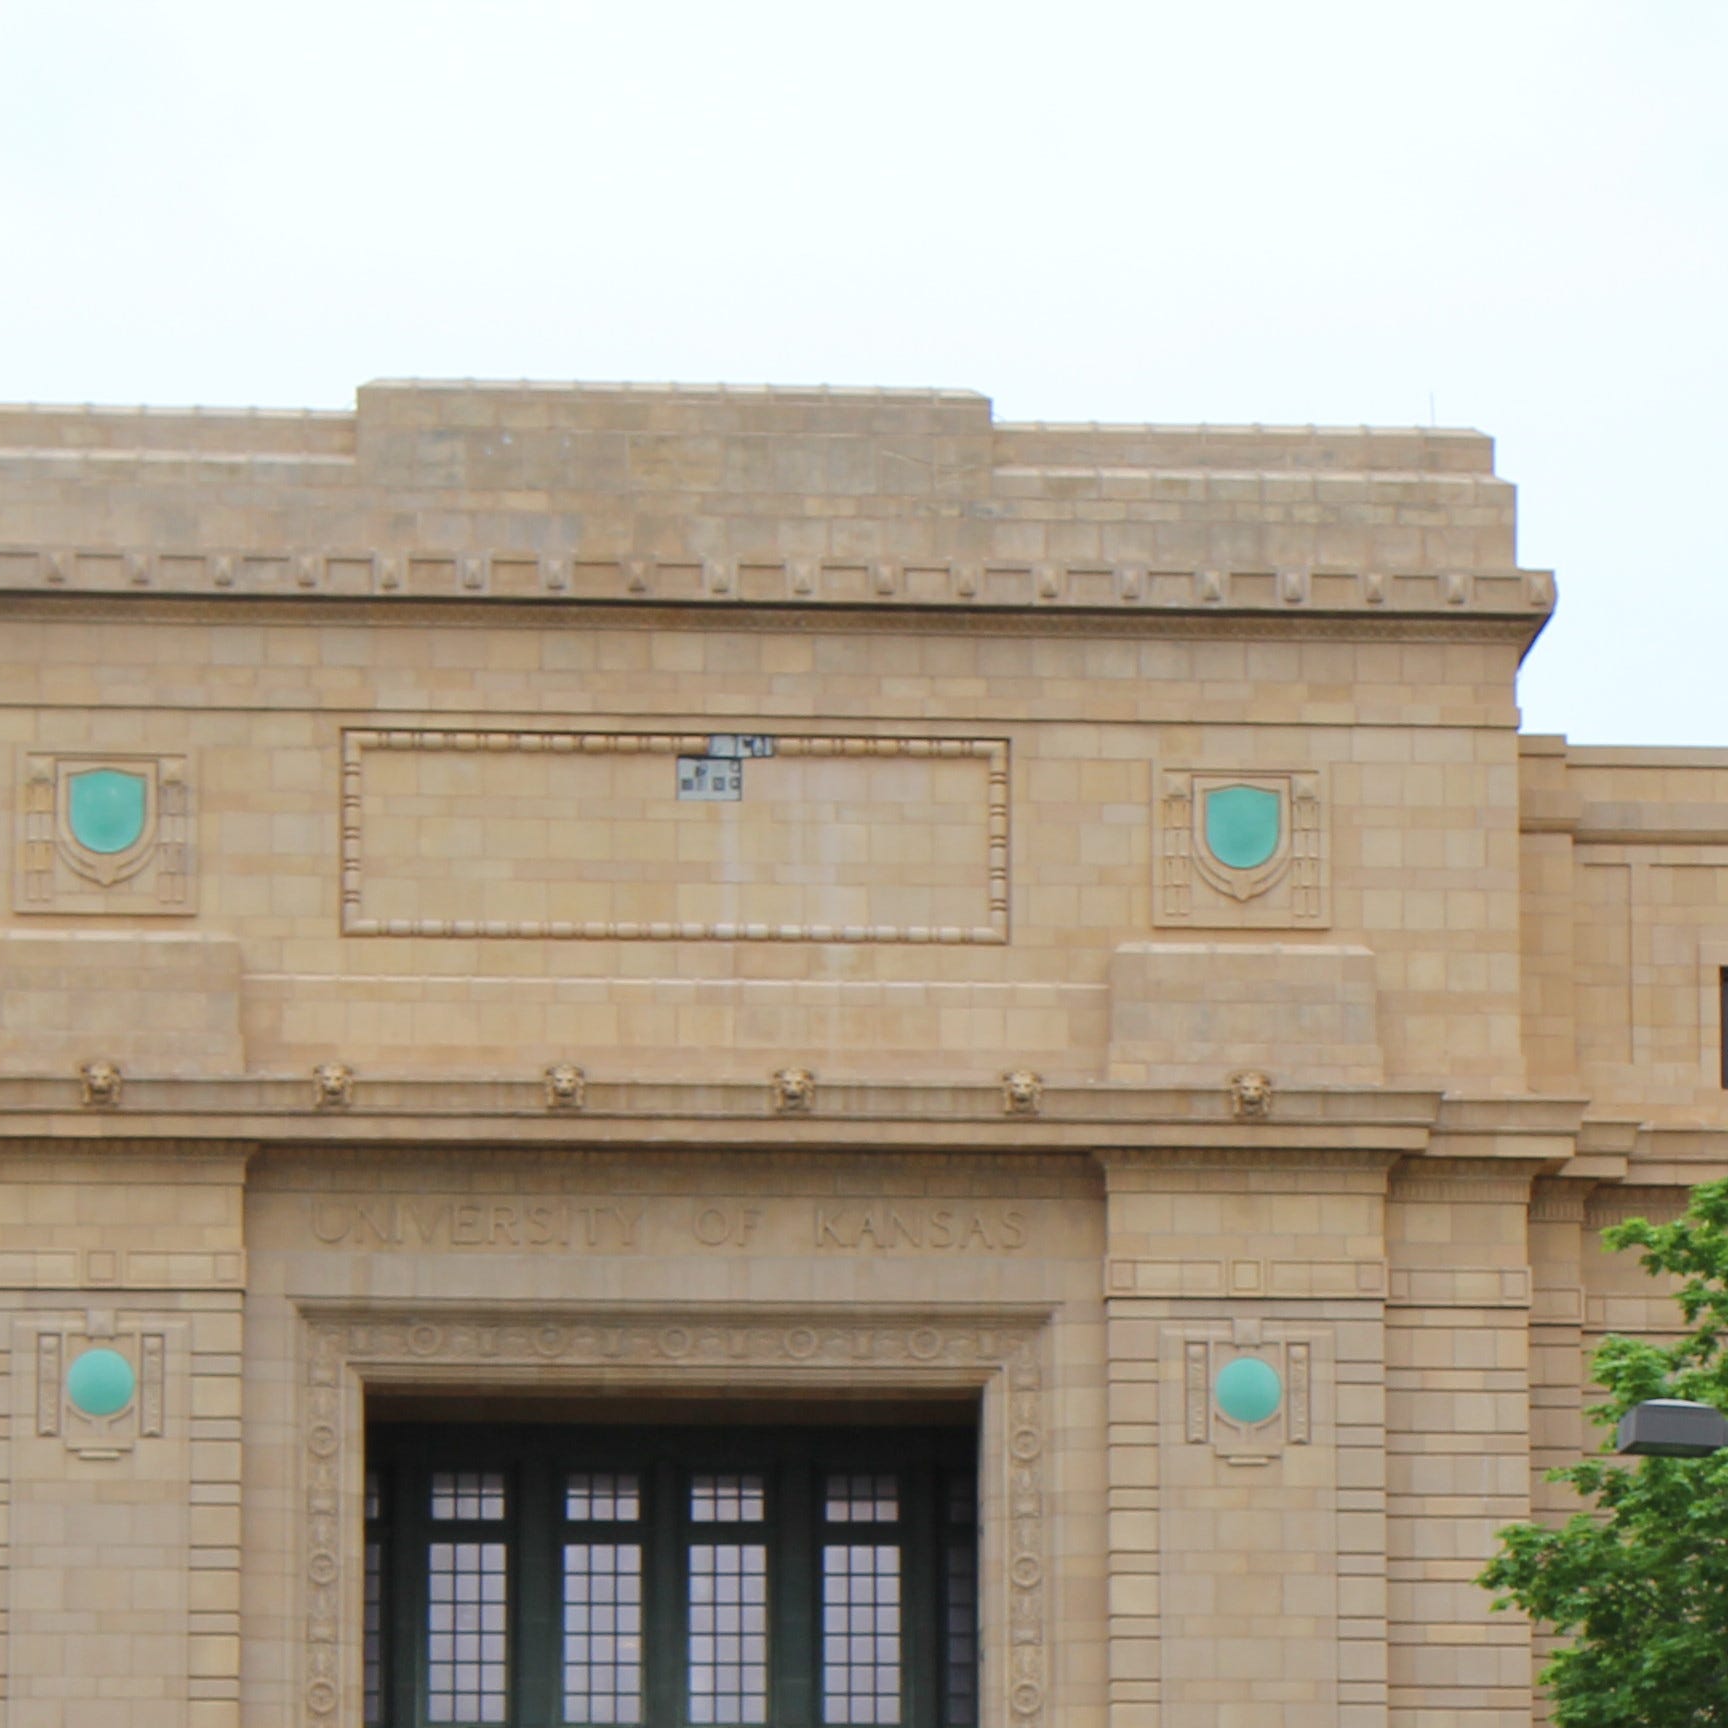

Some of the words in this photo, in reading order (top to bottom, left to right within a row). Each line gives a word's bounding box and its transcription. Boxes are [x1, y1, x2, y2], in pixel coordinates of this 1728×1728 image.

[310, 1203, 644, 1246] UNIVERSITY
[692, 1206, 763, 1248] OF
[813, 1208, 1029, 1250] KANSAS
